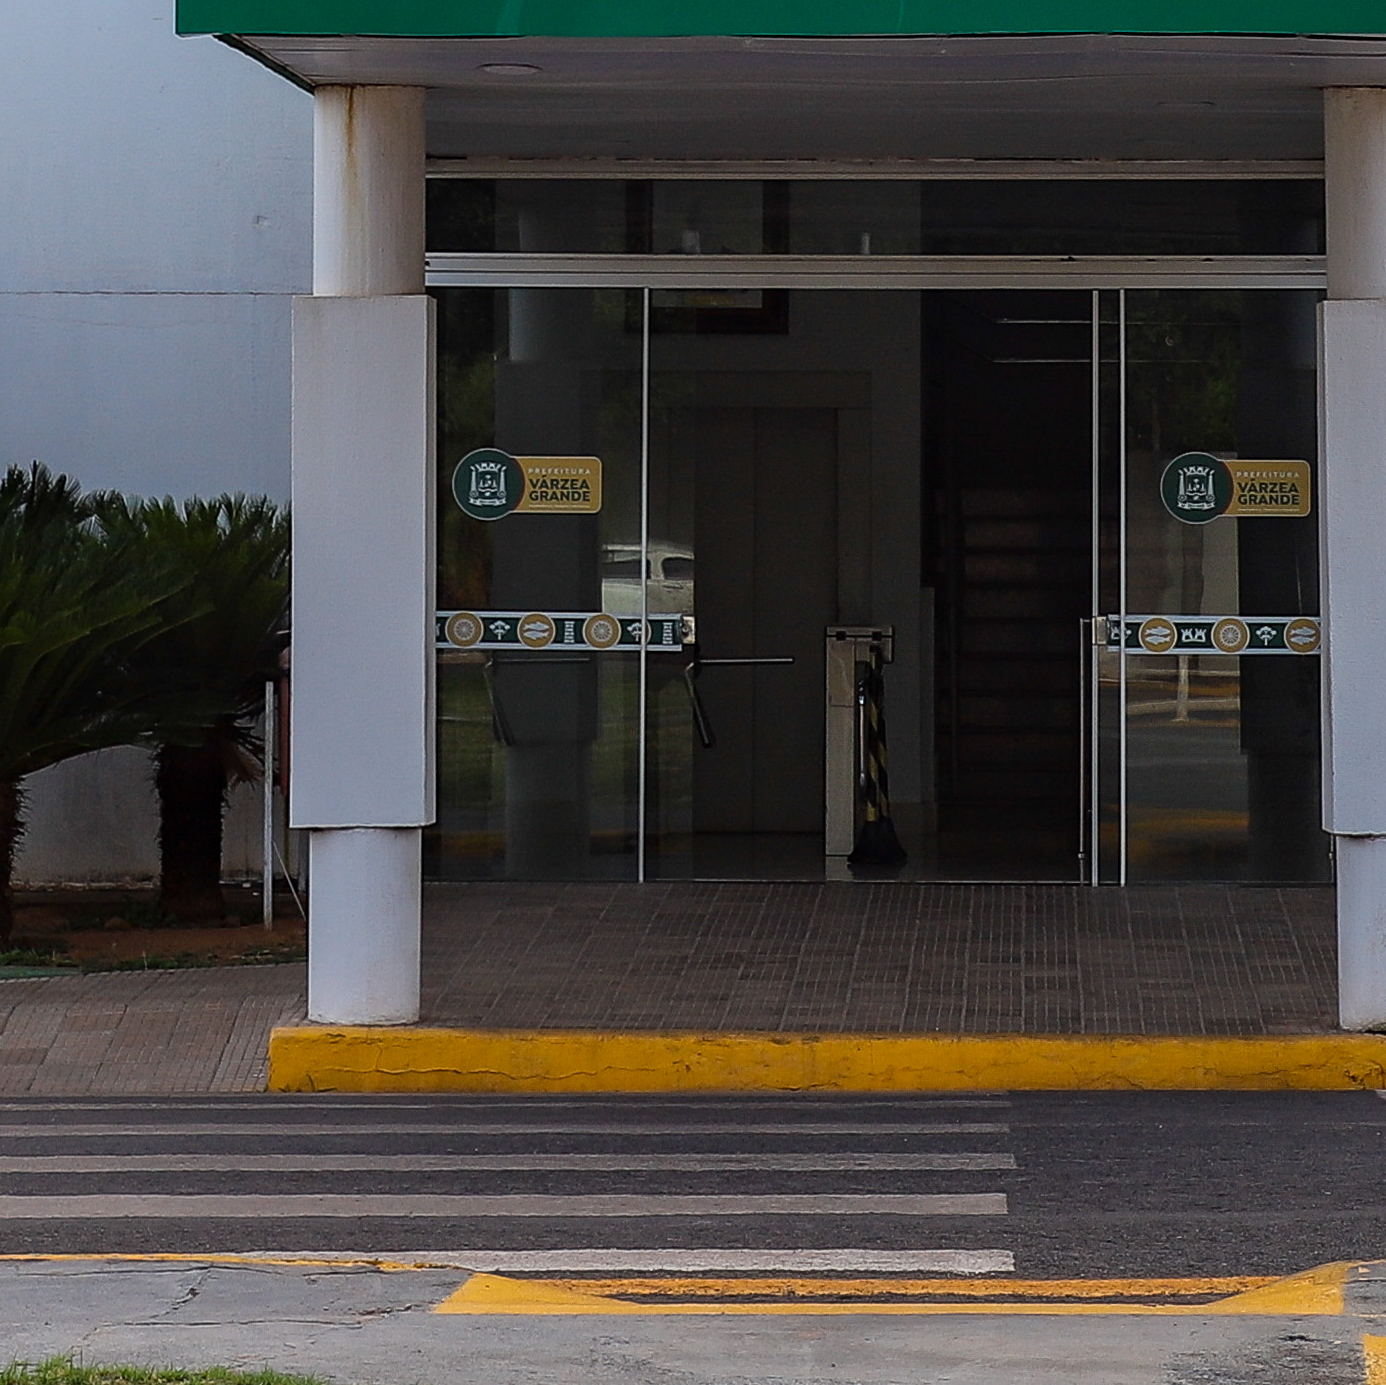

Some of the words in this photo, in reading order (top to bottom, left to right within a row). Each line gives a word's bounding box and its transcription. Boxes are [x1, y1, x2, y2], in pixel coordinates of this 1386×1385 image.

[529, 475, 591, 490] VÁRZEA
[1237, 478, 1300, 494] VÁRZEA
[529, 490, 591, 502] GRANDE
[1237, 494, 1300, 506] GRANDE
